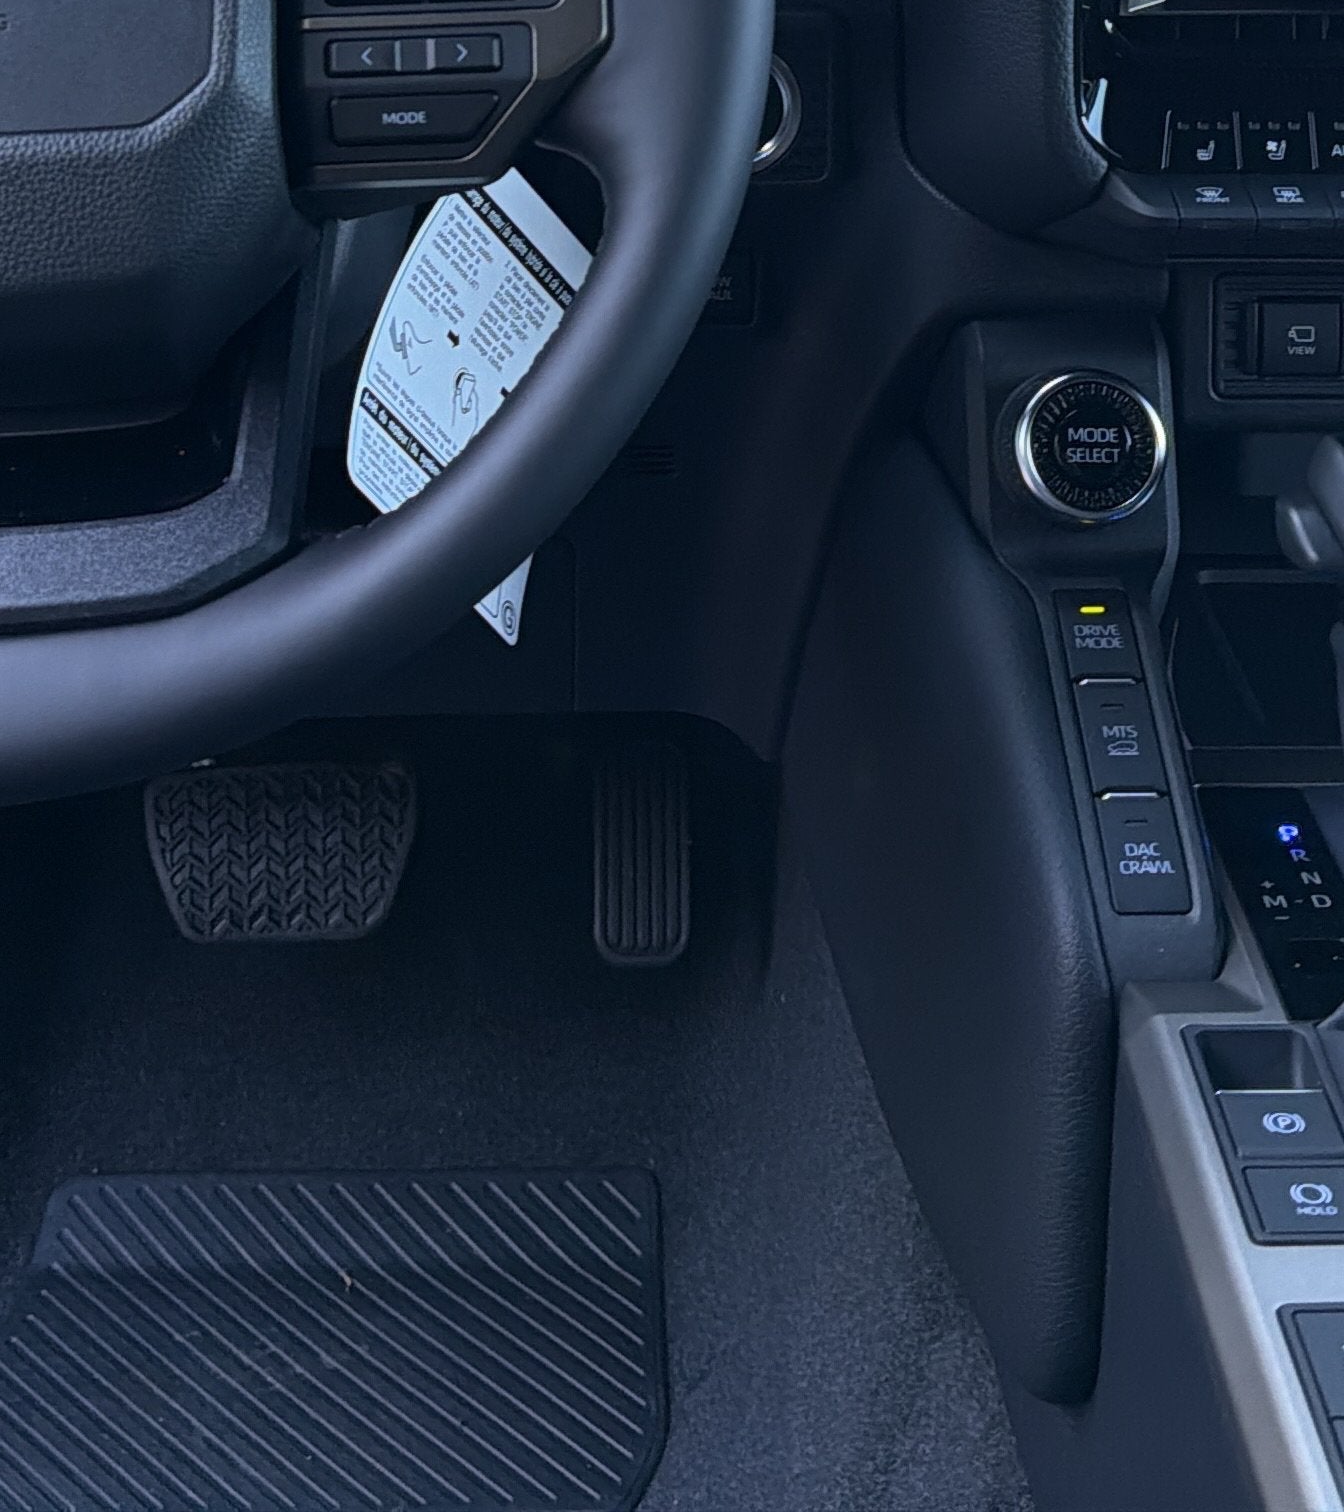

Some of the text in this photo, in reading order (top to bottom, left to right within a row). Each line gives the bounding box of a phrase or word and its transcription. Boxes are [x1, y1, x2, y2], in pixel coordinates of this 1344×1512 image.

[382, 110, 427, 125] MODE
[1287, 346, 1316, 356] VIEW
[1067, 426, 1120, 445] MODE
[1066, 447, 1121, 465] SELECT
[1073, 624, 1121, 637] DRIVE
[1075, 636, 1125, 650] MODE
[1102, 725, 1138, 739] MTS
[1124, 842, 1161, 858] DAC
[1290, 848, 1310, 862] R
[1119, 859, 1176, 875] CRAWL
[1301, 871, 1321, 884] N
[1263, 895, 1331, 908] M D
[1296, 1204, 1338, 1216] HOLD
